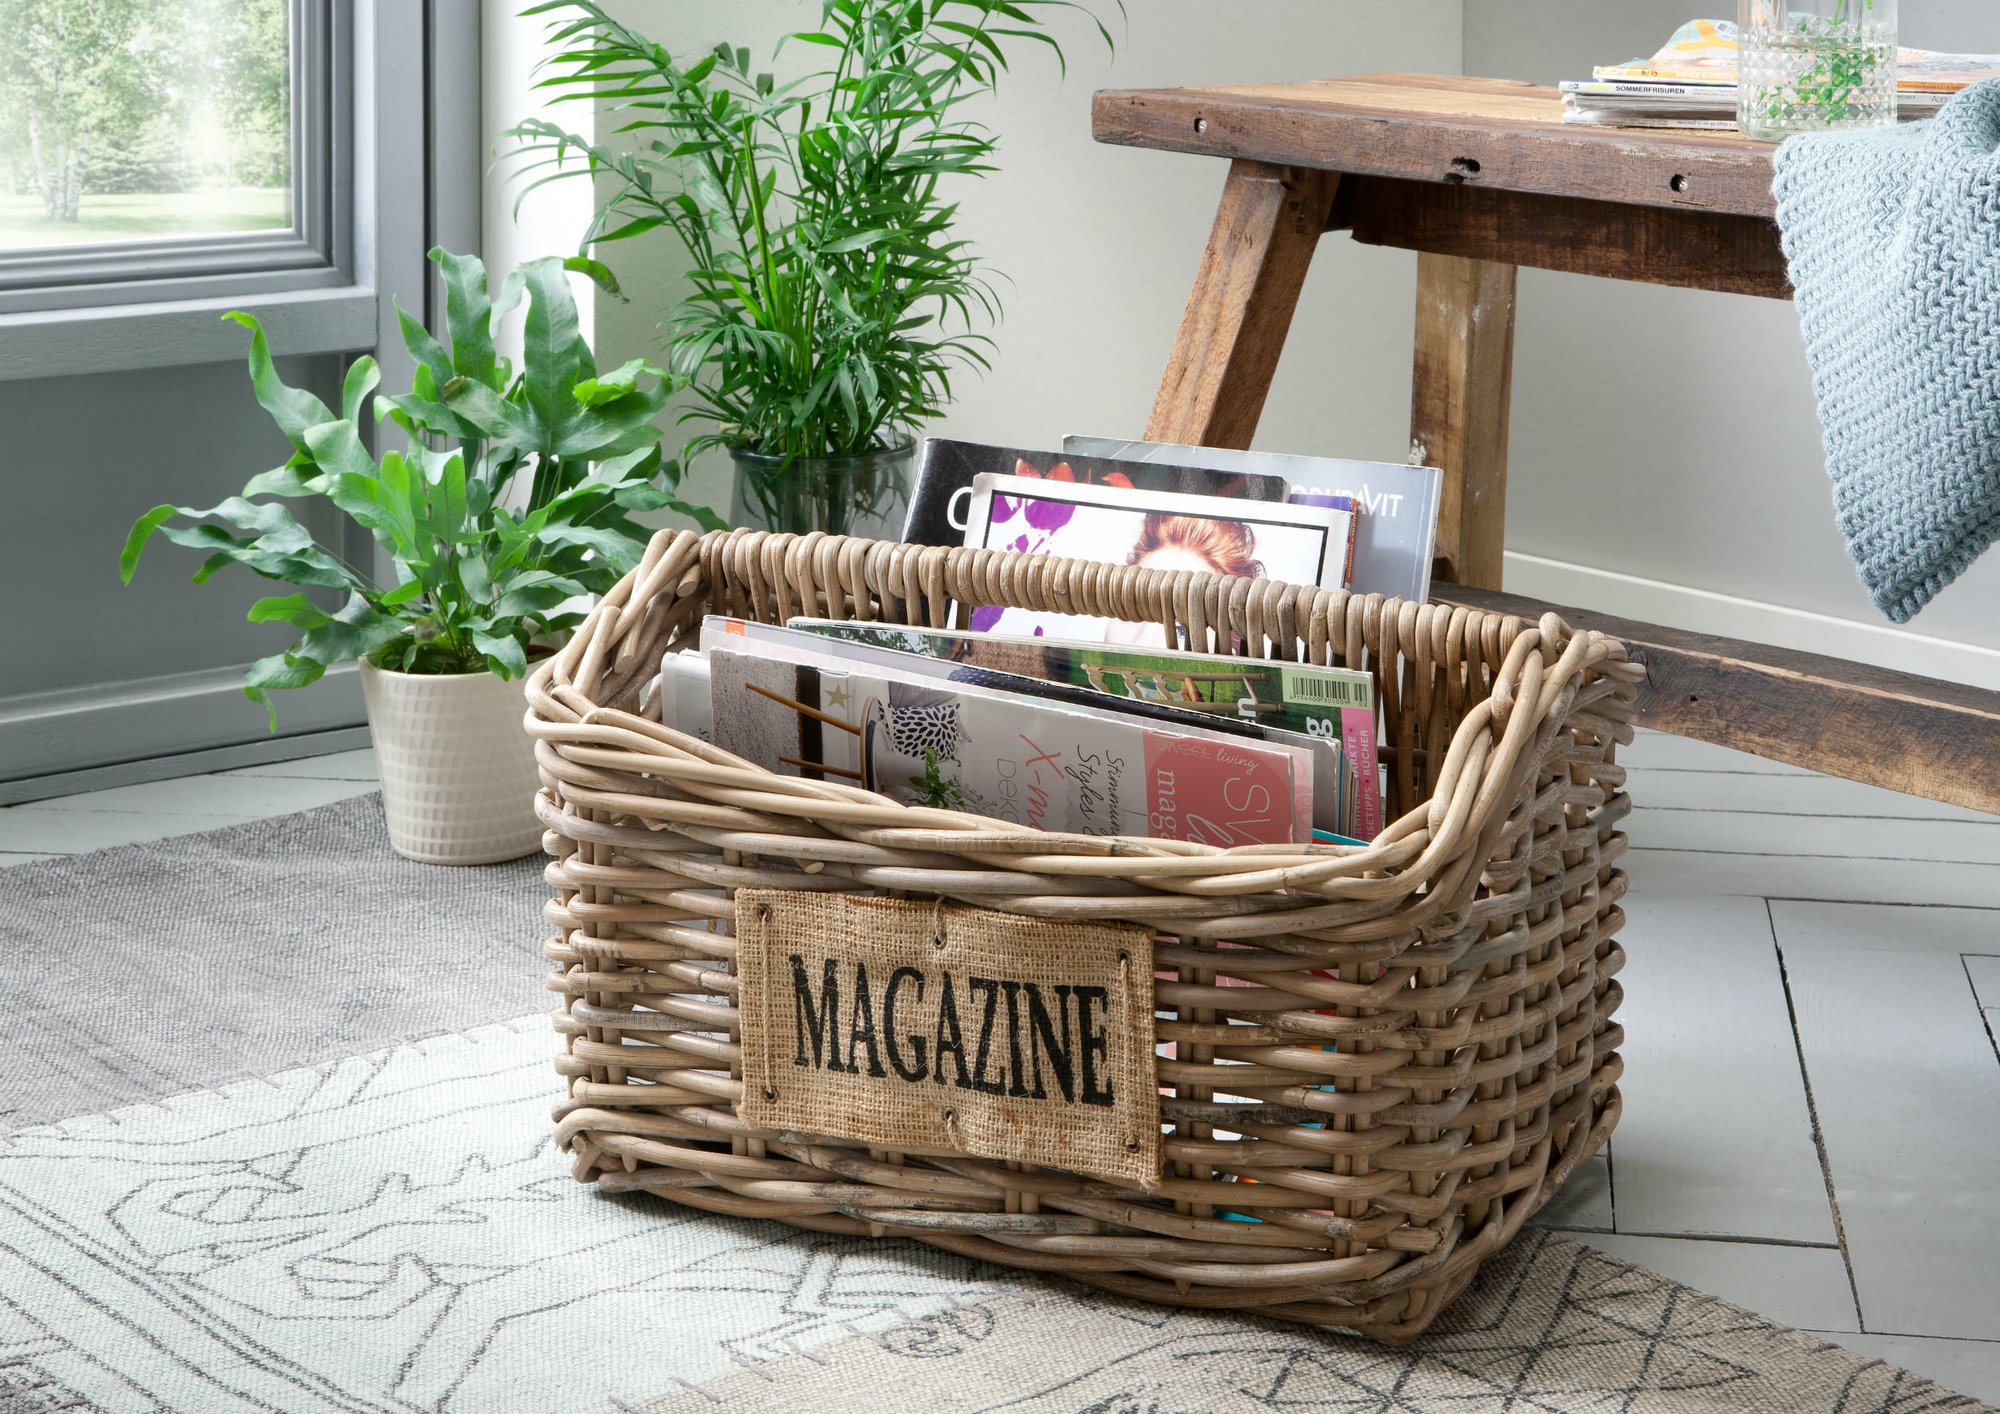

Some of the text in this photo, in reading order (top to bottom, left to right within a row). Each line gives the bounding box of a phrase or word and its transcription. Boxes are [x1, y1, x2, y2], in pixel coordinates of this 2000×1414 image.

[1615, 85, 1686, 95] SOMMERFRISUREN
[1216, 747, 1259, 776] living
[1347, 735, 1358, 778] ARKTE
[1359, 729, 1371, 776] BÜCHER
[1064, 744, 1104, 821] Styles
[788, 953, 1116, 1108] MAGAZINE
